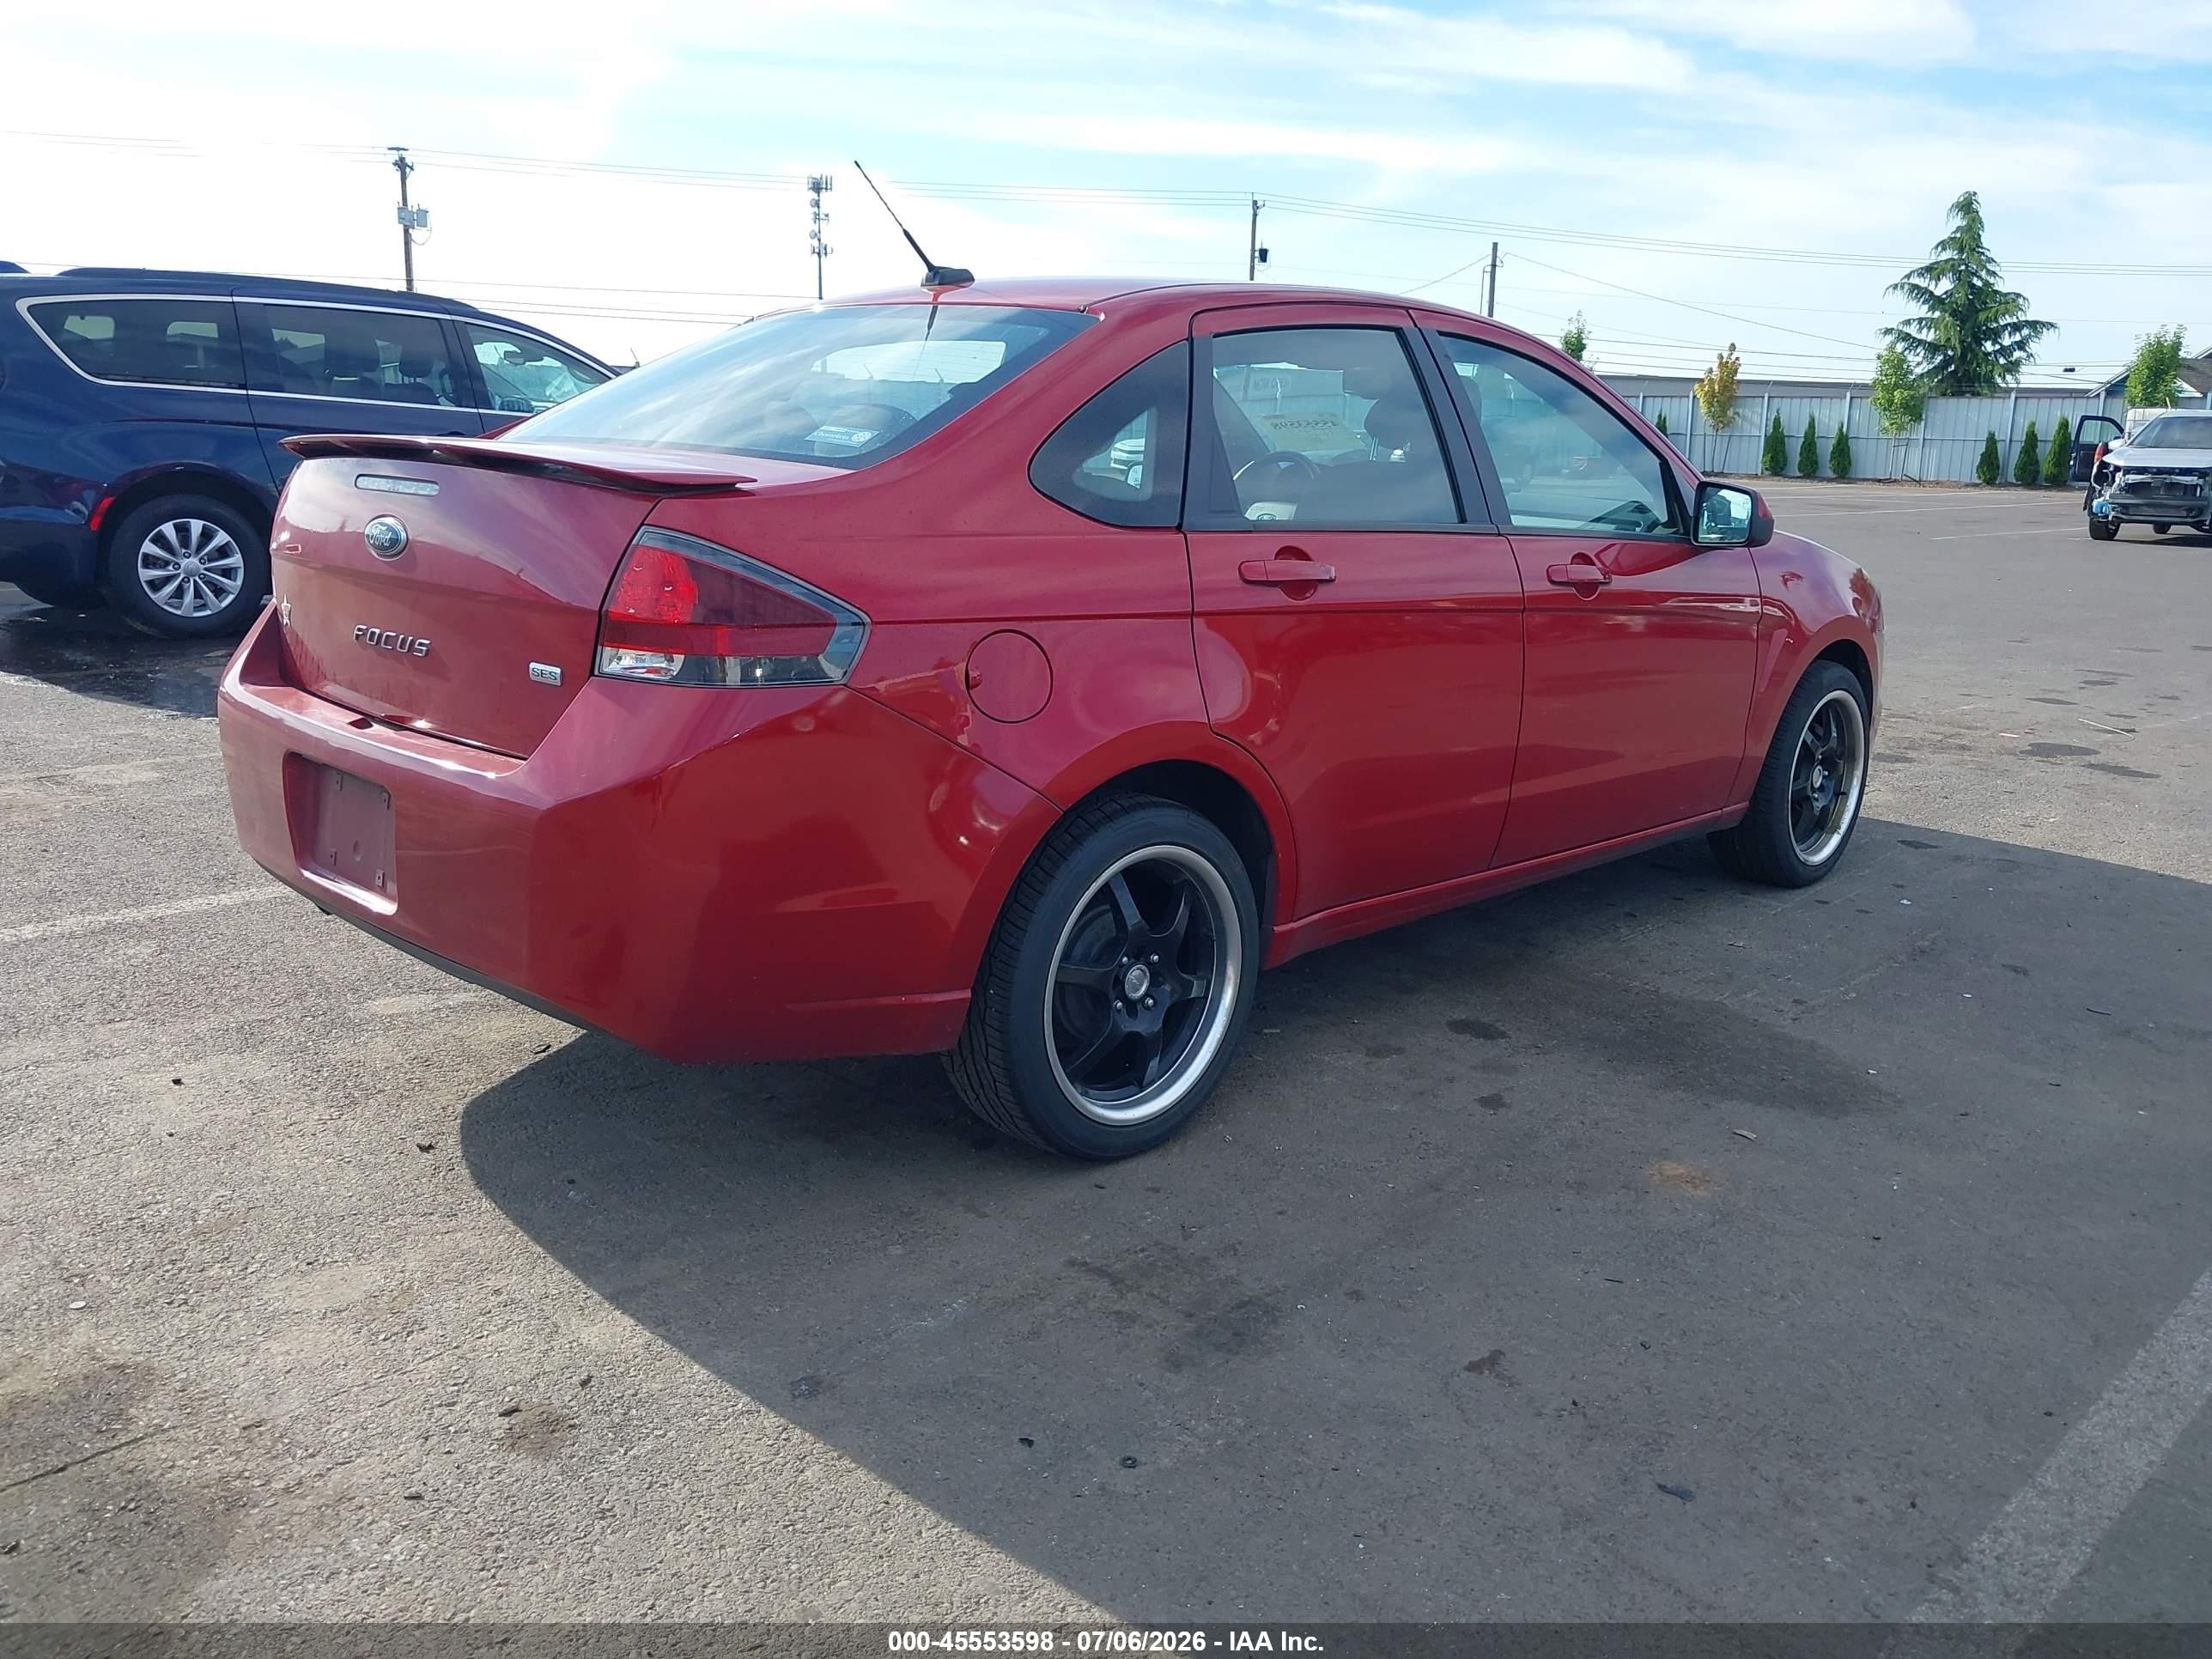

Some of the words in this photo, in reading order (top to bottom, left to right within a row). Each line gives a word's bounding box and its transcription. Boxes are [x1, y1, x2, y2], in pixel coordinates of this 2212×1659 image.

[369, 524, 392, 547] Ford
[353, 624, 431, 658] FOCUS
[531, 666, 559, 682] SES
